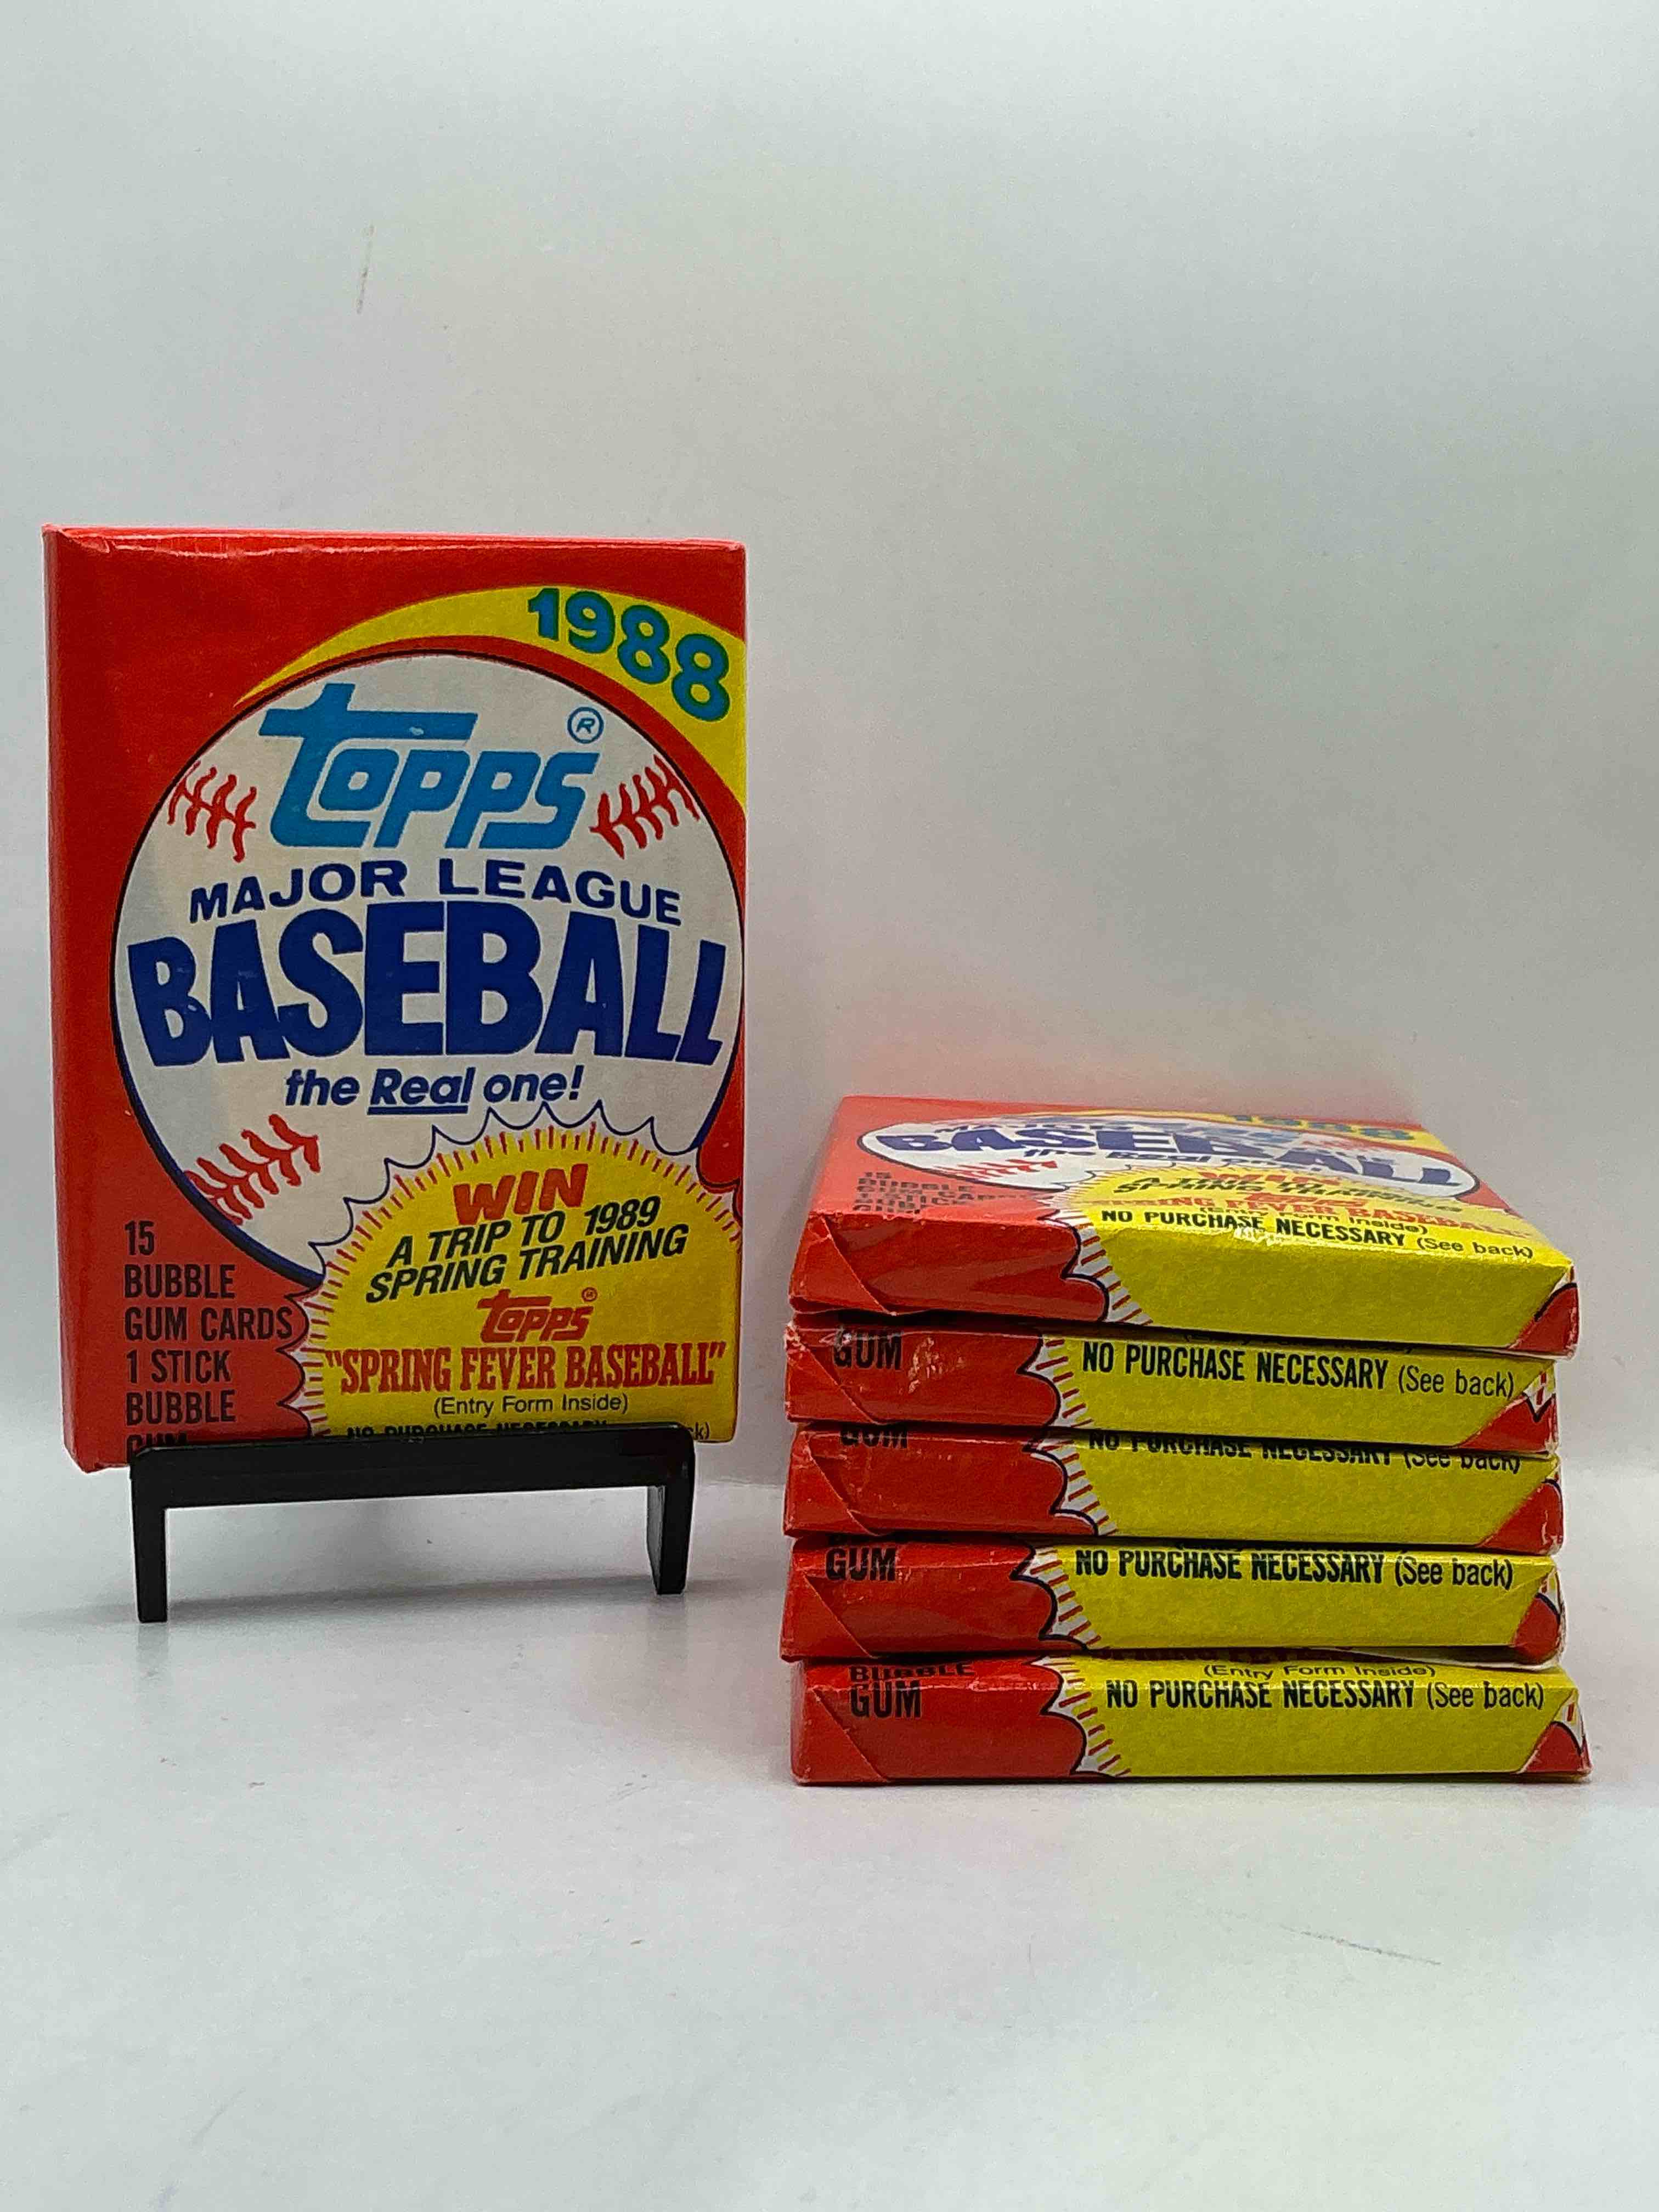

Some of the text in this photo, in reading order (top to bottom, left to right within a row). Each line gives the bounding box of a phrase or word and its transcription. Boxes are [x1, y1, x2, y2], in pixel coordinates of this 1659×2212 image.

[527, 587, 731, 722] 1988
[189, 859, 681, 926] MAJOR LEAGUE
[127, 900, 726, 1066] BASEBALL
[285, 1065, 583, 1115] the Real one!
[876, 1128, 1462, 1187] BASEBALL
[453, 1163, 588, 1226] WIN
[125, 1220, 155, 1256] 15
[386, 1195, 661, 1268] A TRIP TO 1989
[1101, 1210, 1534, 1260] NO PURCHASE NECESSARY (See back)
[124, 1264, 236, 1299] BUBBLE
[366, 1223, 689, 1303] SPRING TRAINING
[125, 1306, 293, 1341] GUM CARDS
[126, 1349, 232, 1384] 1 STICK
[459, 1345, 556, 1391] FEVER
[833, 1329, 902, 1370] GUM
[1083, 1341, 1515, 1400] NO PURCHASE NECESSARY (See back)
[126, 1390, 236, 1426] BUBBLE
[433, 1393, 629, 1419] (Entry Form Inside)
[825, 1545, 896, 1581] GUM
[1074, 1548, 1514, 1589] NO PURCHASE NECESSARY (See back)
[1204, 1663, 1436, 1680] (Entry Form Inside)
[850, 1680, 922, 1718] GUM
[1106, 1680, 1544, 1711] NO PURCHASE NECESSARY (See back)
